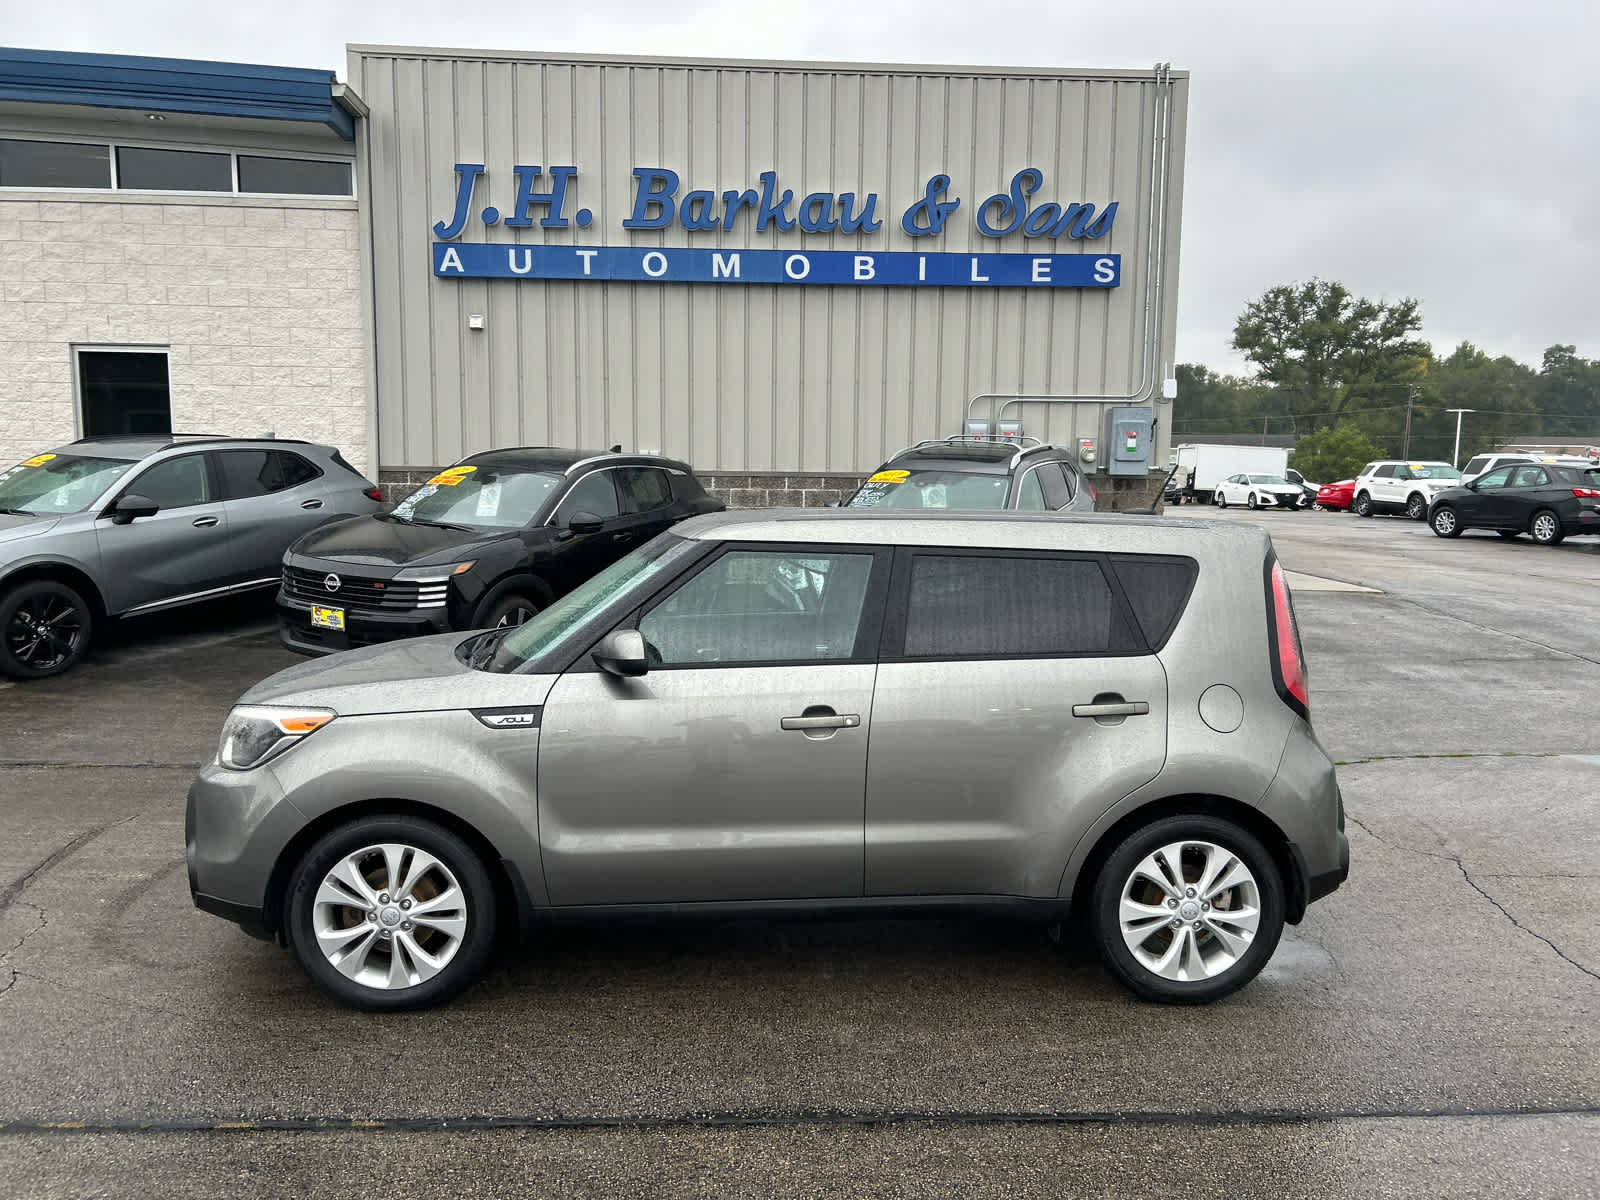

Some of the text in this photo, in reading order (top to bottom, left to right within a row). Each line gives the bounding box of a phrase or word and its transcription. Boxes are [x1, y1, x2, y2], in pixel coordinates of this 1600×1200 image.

[433, 163, 1120, 239] J.H. Barkau & Sons
[439, 247, 1115, 284] AUTOMOBILES
